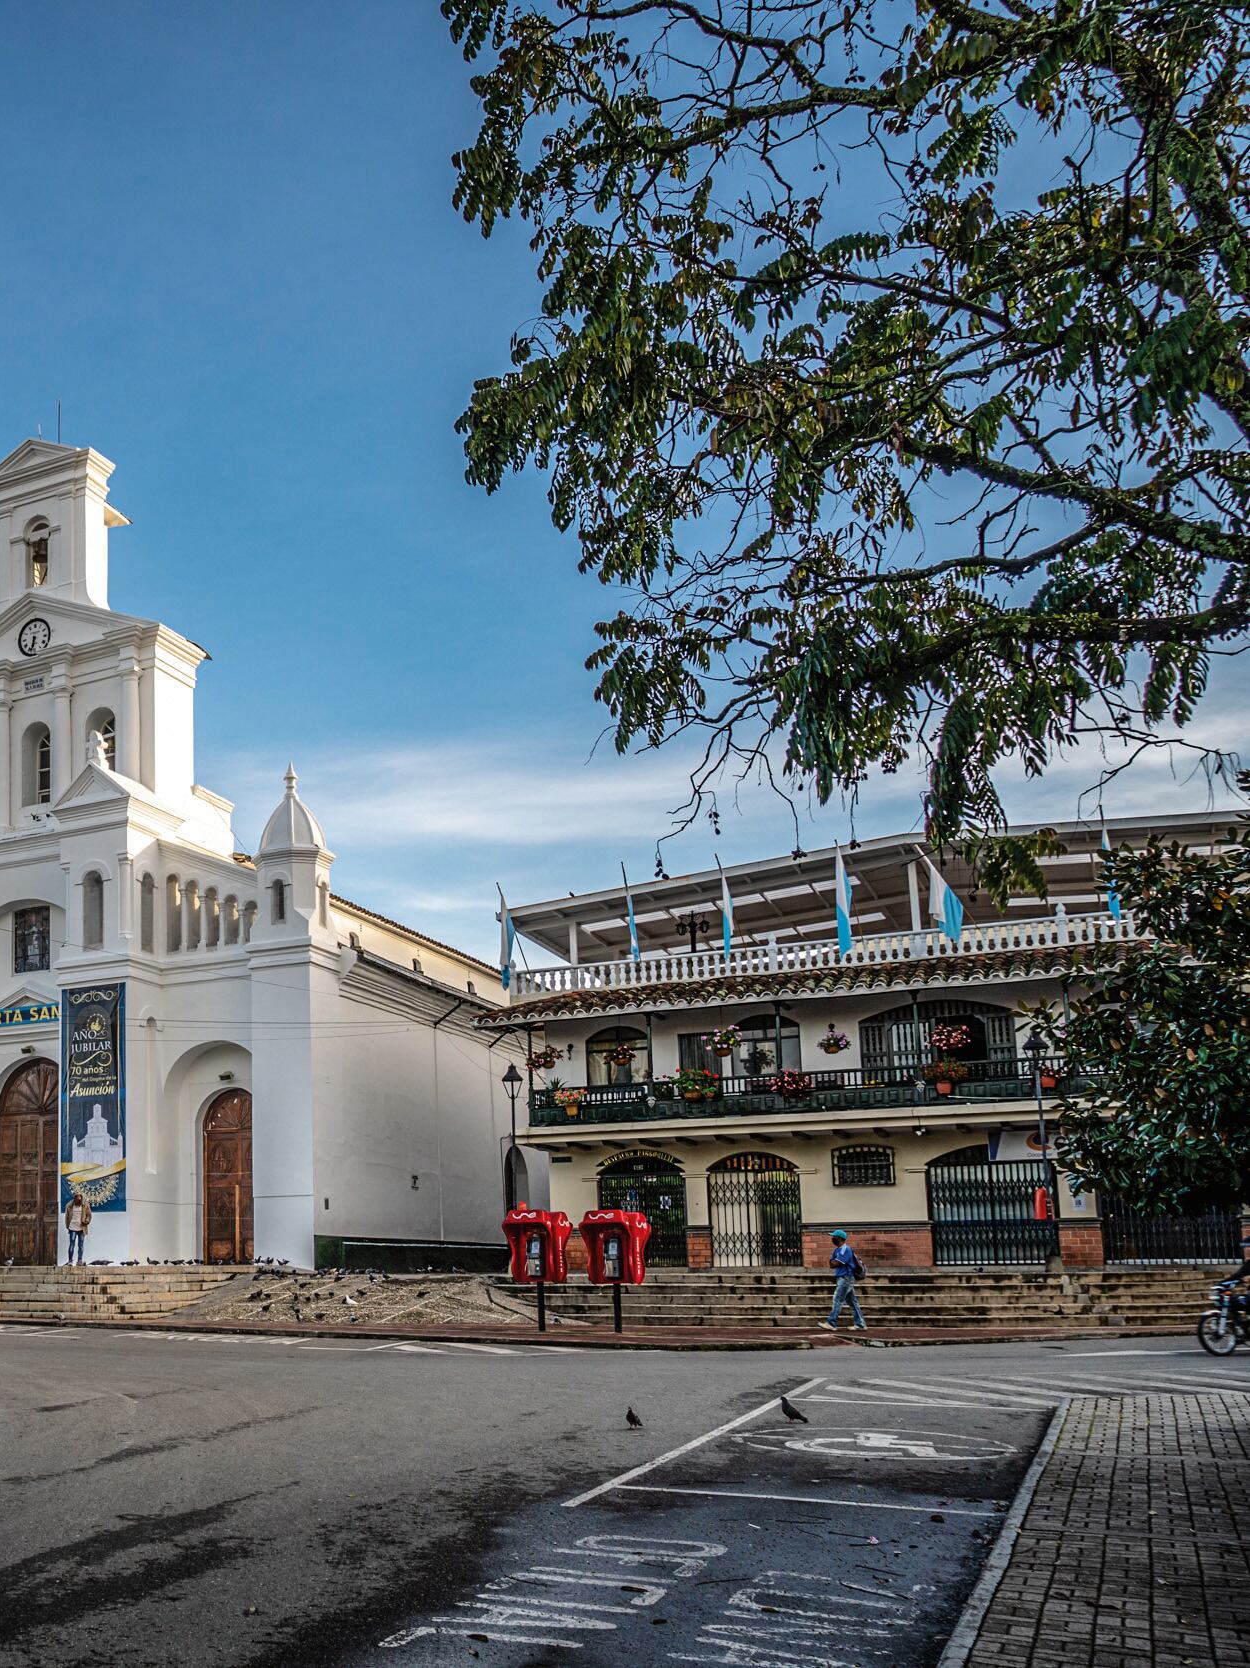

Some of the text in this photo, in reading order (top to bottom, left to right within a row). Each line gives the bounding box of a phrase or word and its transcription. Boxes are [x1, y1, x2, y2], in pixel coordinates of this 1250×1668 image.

[72, 1029, 96, 1040] AÑO
[70, 1040, 112, 1054] JUBILAR
[70, 1065, 104, 1075] 70 años
[70, 1081, 116, 1098] Asunción
[378, 1534, 728, 1648] OFICIAL
